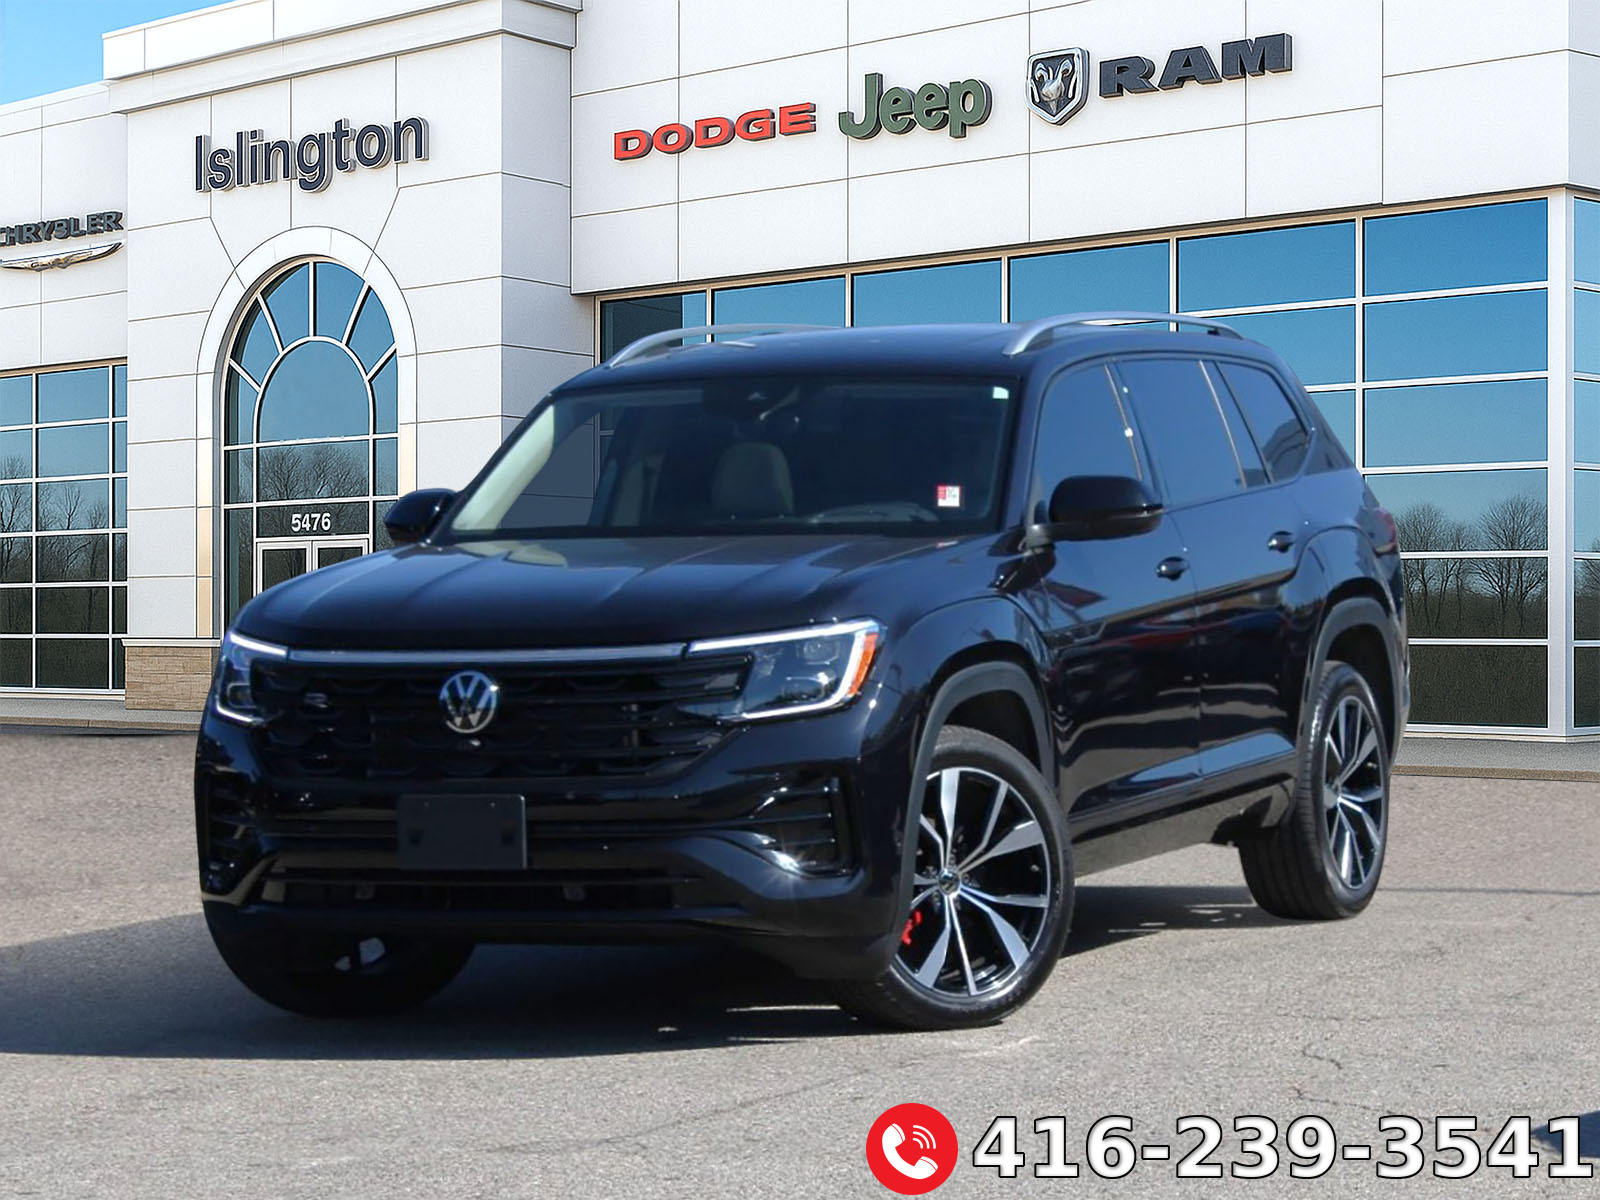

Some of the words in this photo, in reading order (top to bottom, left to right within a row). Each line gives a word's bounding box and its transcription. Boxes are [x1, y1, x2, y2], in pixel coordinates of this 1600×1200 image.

[1099, 33, 1293, 97] RAM
[614, 102, 817, 160] DODGE
[839, 73, 992, 139] Jeep
[195, 116, 428, 192] Islington
[291, 513, 331, 532] 5476
